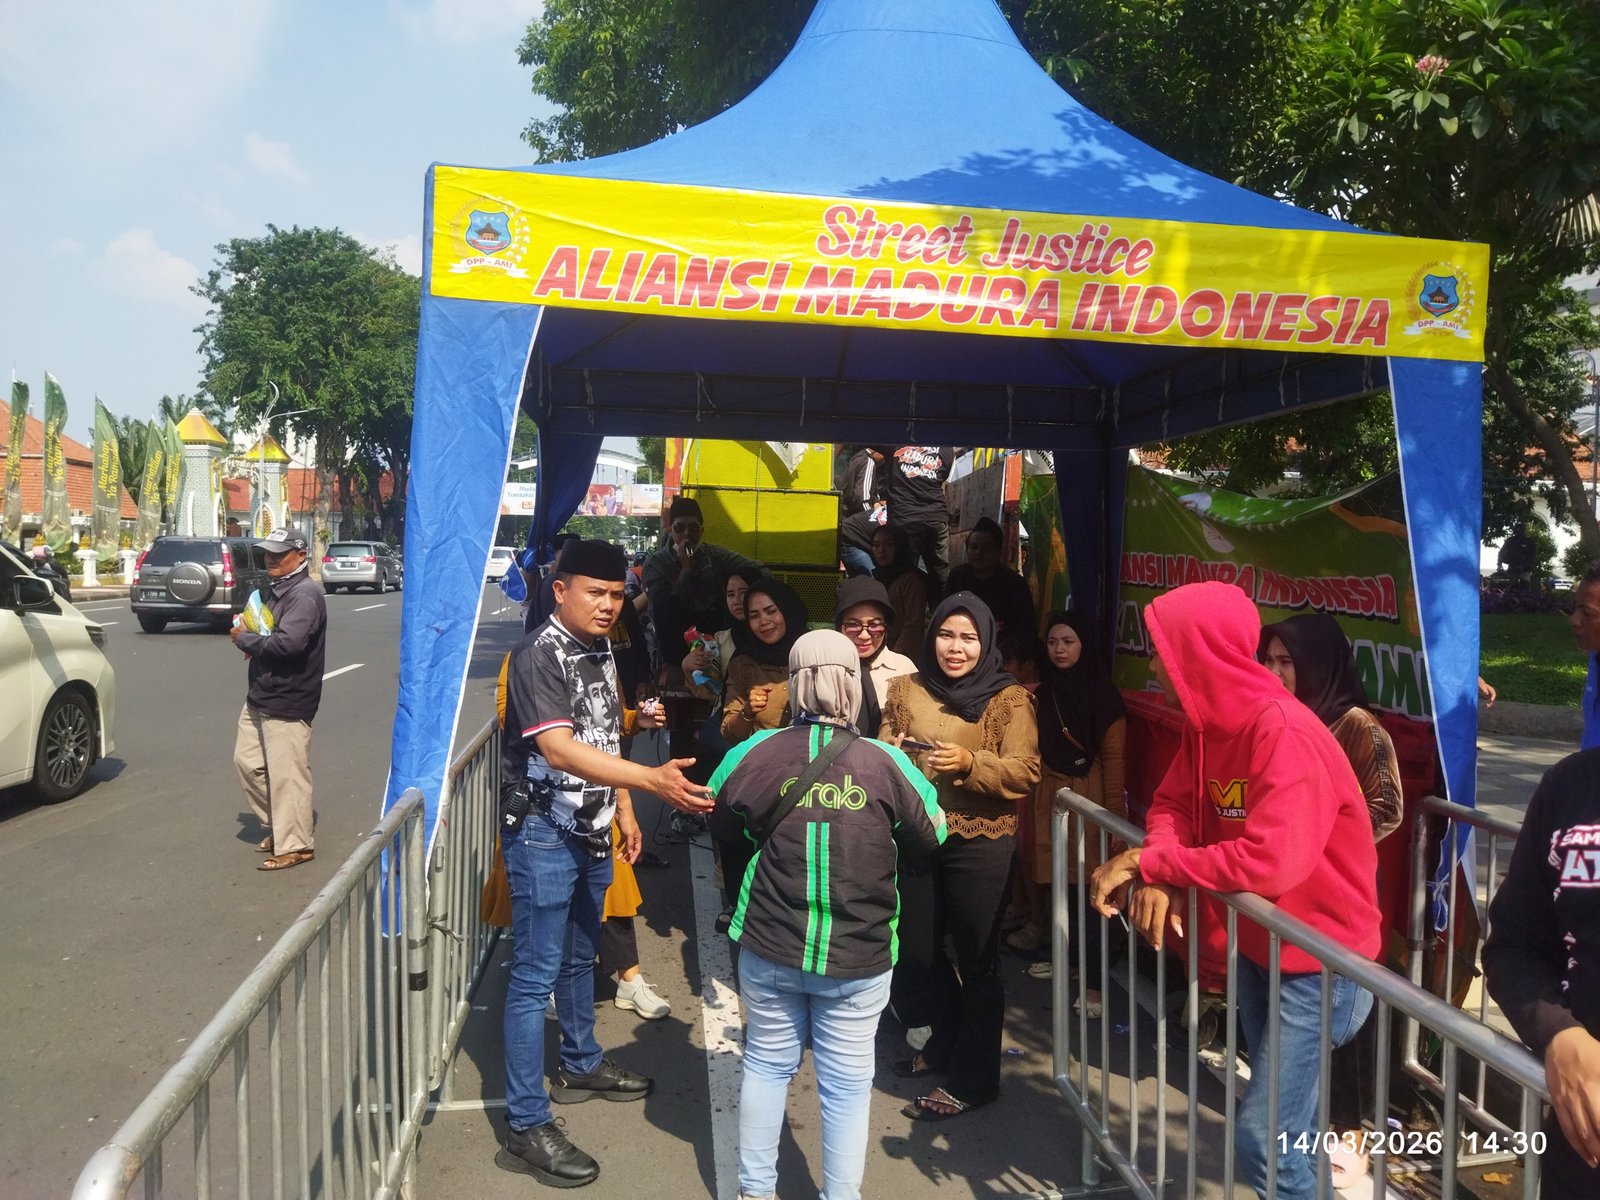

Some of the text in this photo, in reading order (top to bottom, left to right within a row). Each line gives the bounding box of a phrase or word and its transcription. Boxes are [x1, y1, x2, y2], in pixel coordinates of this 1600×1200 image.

[466, 257, 486, 266] DPP
[494, 259, 513, 269] AMI
[817, 205, 1154, 277] Street Justice
[532, 246, 1391, 348] ALIANSI MADURA INDONESIA
[1417, 320, 1435, 328] DPP
[1442, 320, 1460, 330] AMI
[98, 440, 110, 492] Marhaban
[109, 438, 119, 484] Ramadan
[106, 485, 118, 499] Ya
